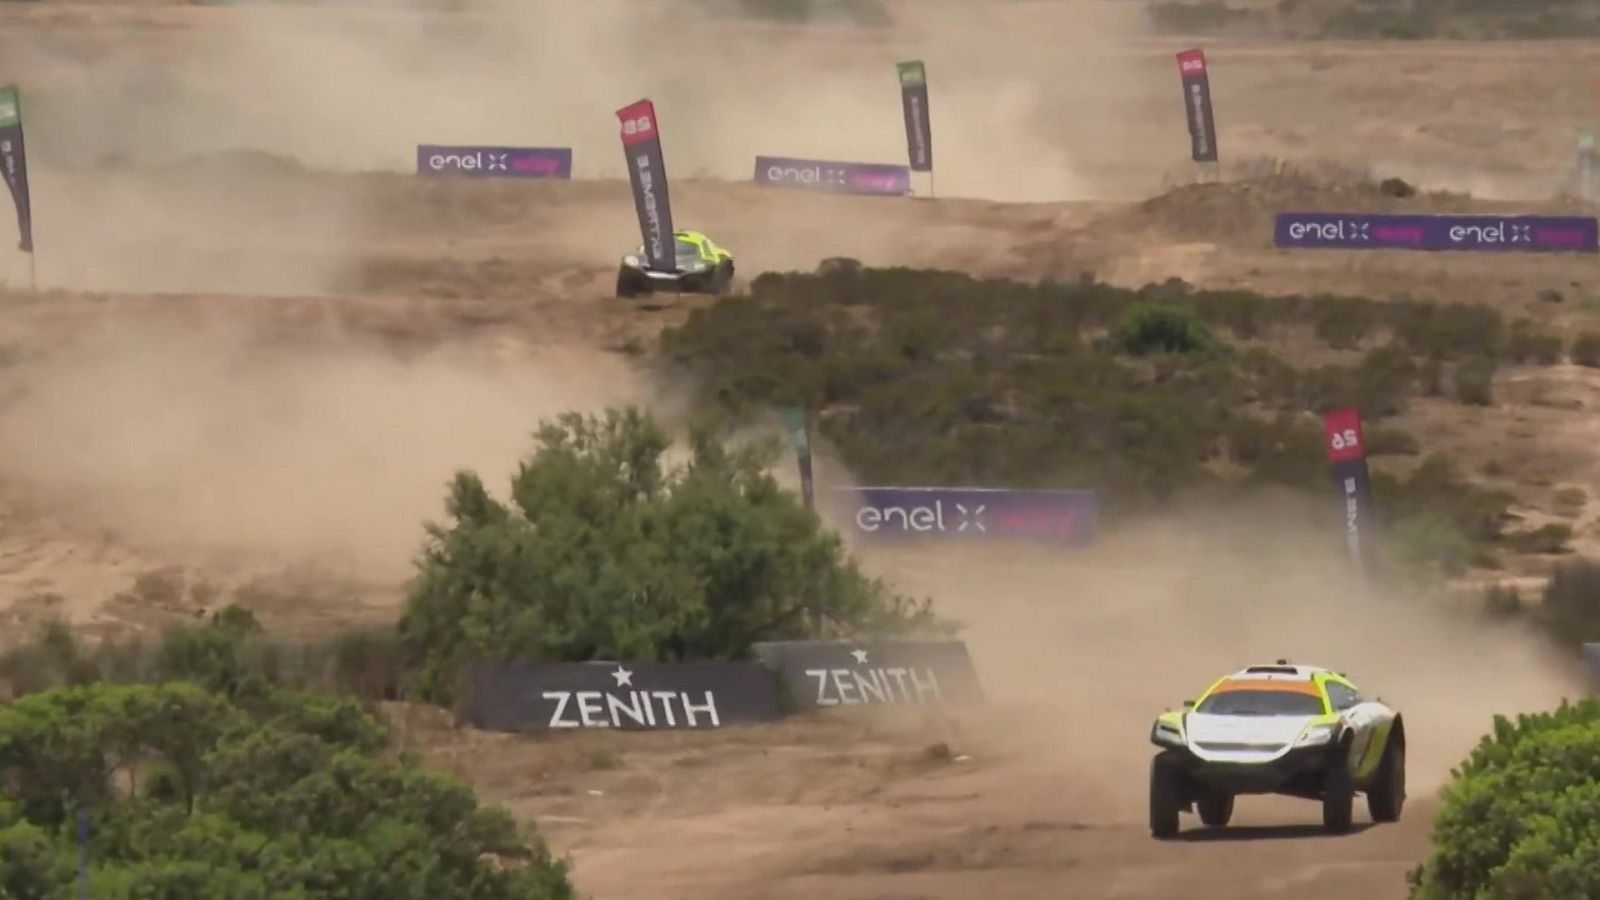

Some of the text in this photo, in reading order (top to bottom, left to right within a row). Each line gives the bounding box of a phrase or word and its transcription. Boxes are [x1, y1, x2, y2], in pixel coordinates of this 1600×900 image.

[429, 151, 482, 170] enel
[767, 165, 820, 183] enel
[1289, 219, 1345, 240] enel
[1449, 221, 1505, 243] enel
[856, 499, 946, 532] enel
[805, 668, 941, 706] ZENITH
[542, 690, 720, 728] ZENITH
